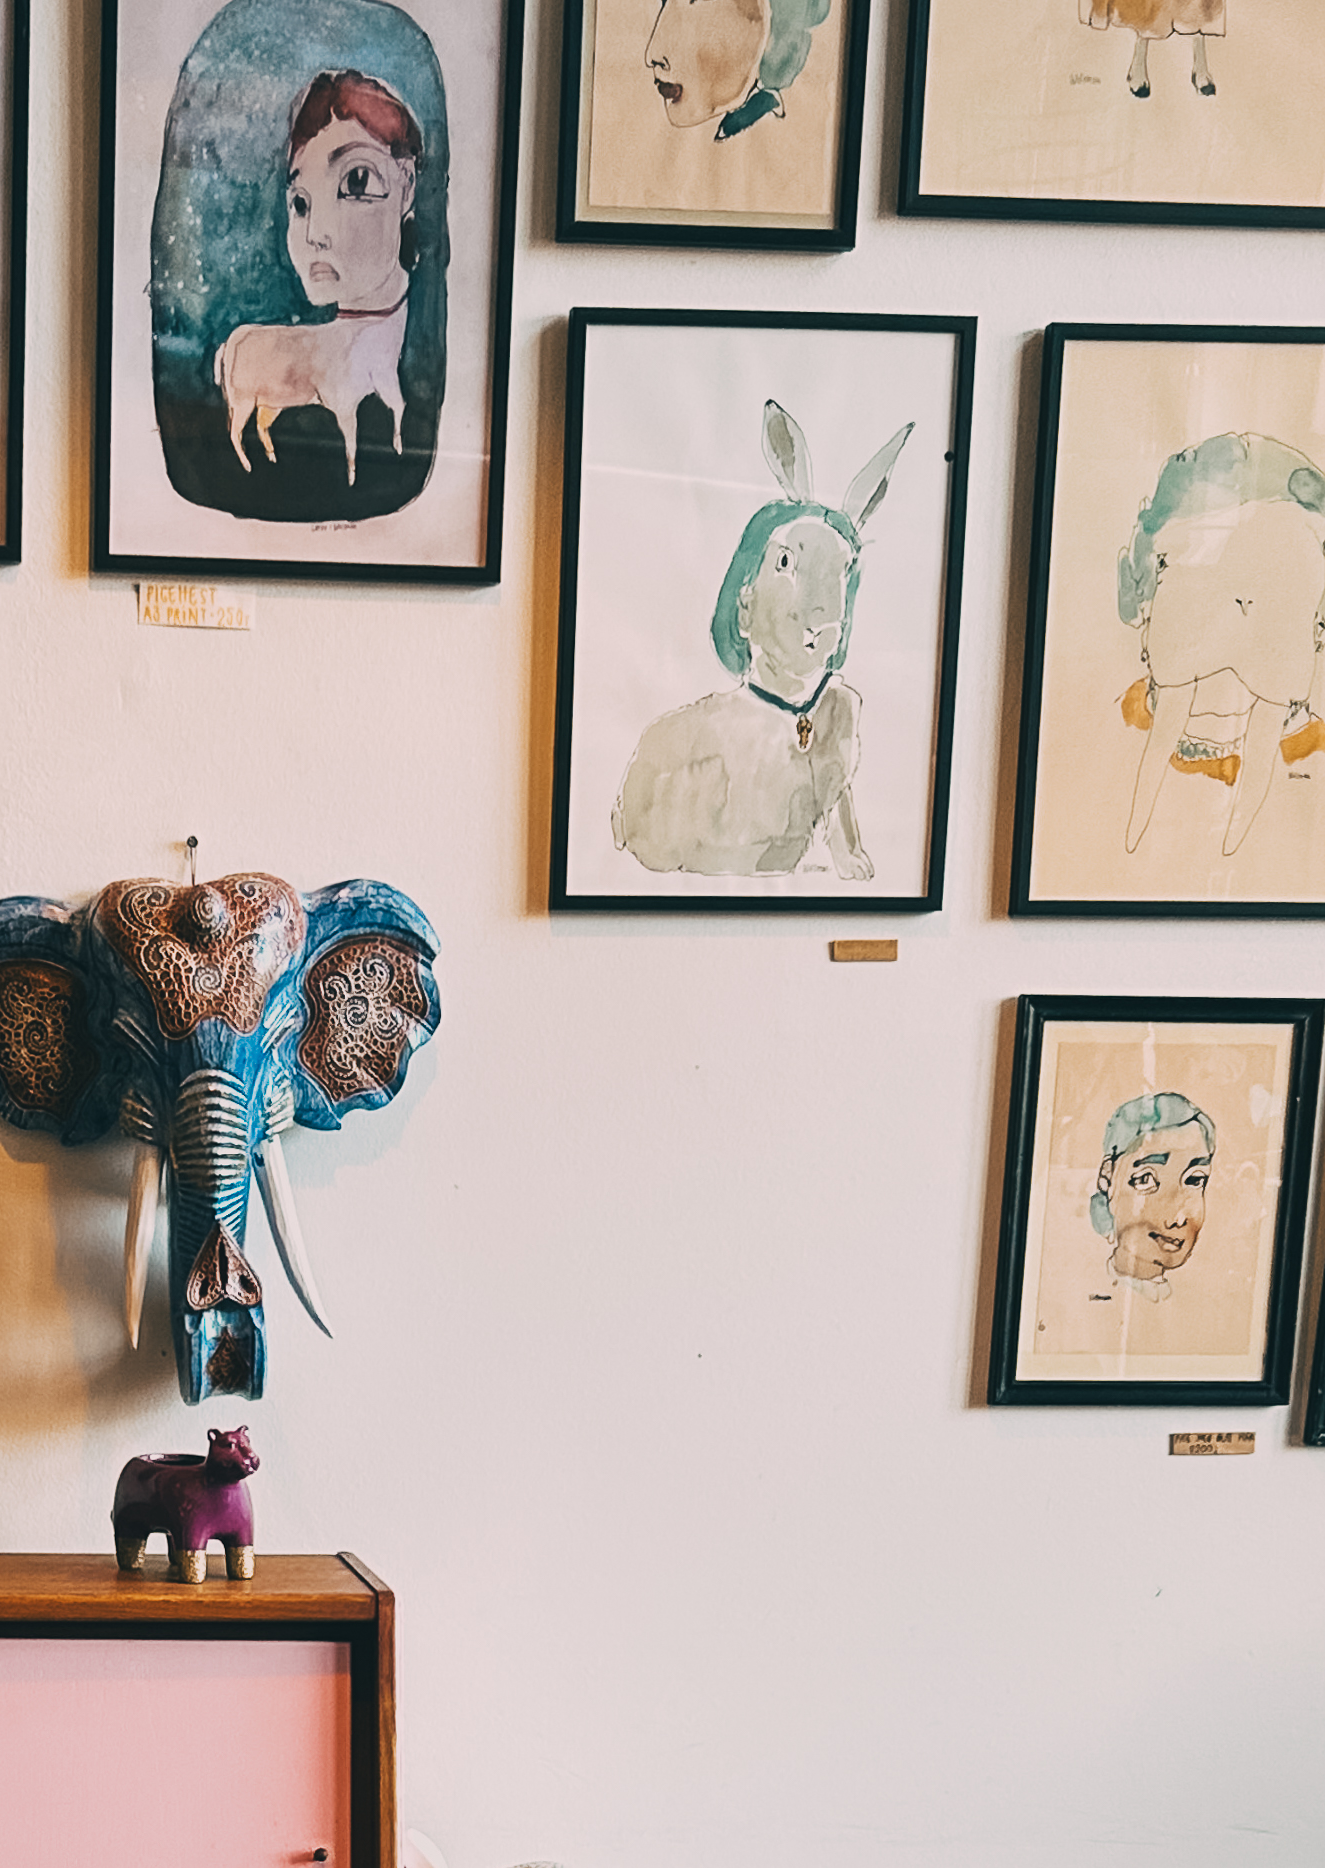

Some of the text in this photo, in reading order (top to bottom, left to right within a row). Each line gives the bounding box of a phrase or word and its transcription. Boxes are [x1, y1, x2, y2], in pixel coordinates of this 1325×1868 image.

[146, 584, 218, 606] PIGEHEST
[143, 605, 160, 623] A3
[166, 605, 207, 626] PRINT
